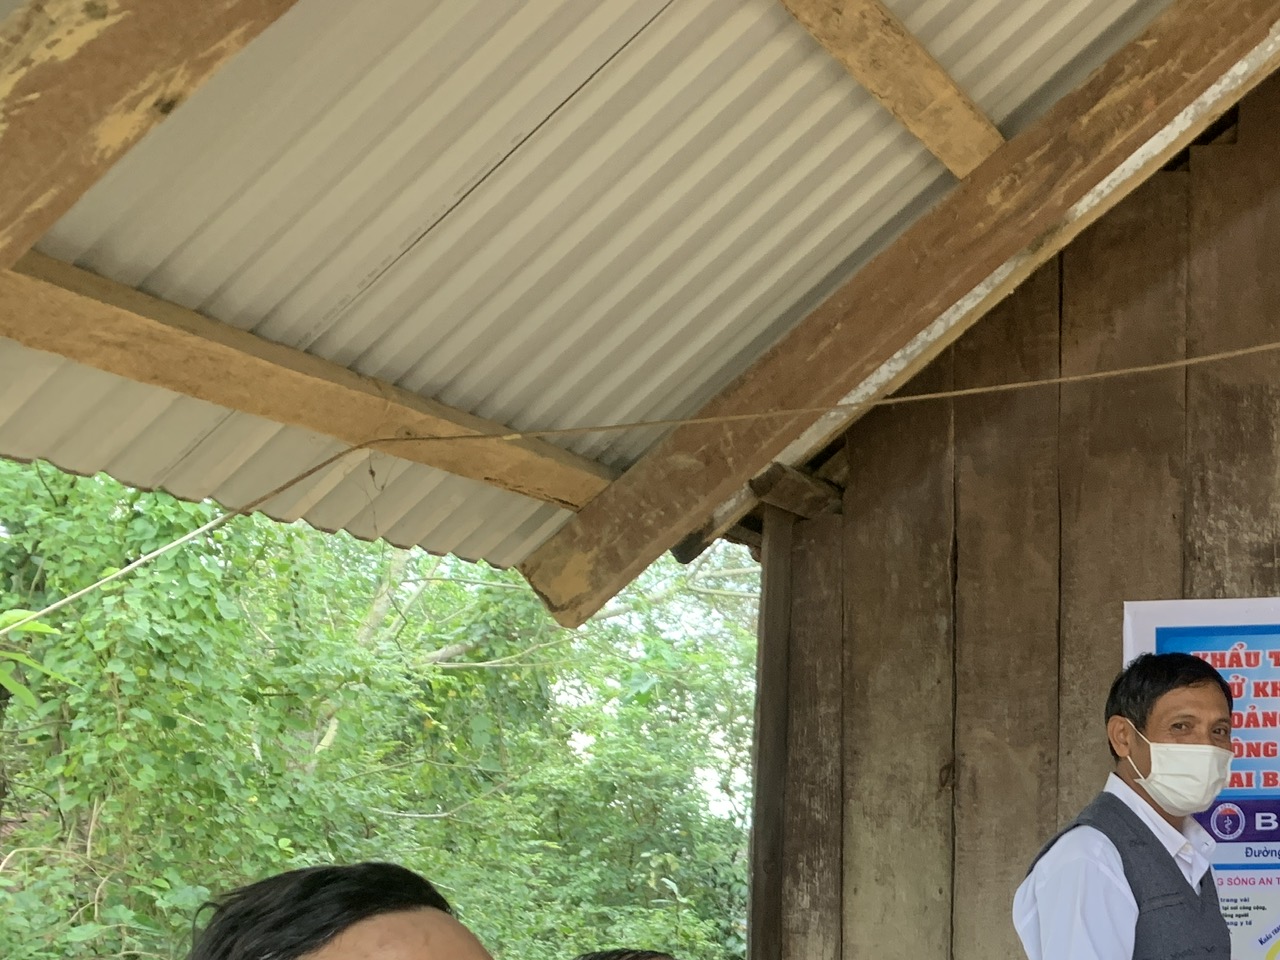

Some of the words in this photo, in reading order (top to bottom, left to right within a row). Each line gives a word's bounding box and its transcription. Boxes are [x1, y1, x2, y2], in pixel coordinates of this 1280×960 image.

[1193, 643, 1260, 667] HẨU
[1231, 738, 1278, 758] ÔNG
[1229, 772, 1253, 787] AI
[1258, 877, 1273, 886] AN
